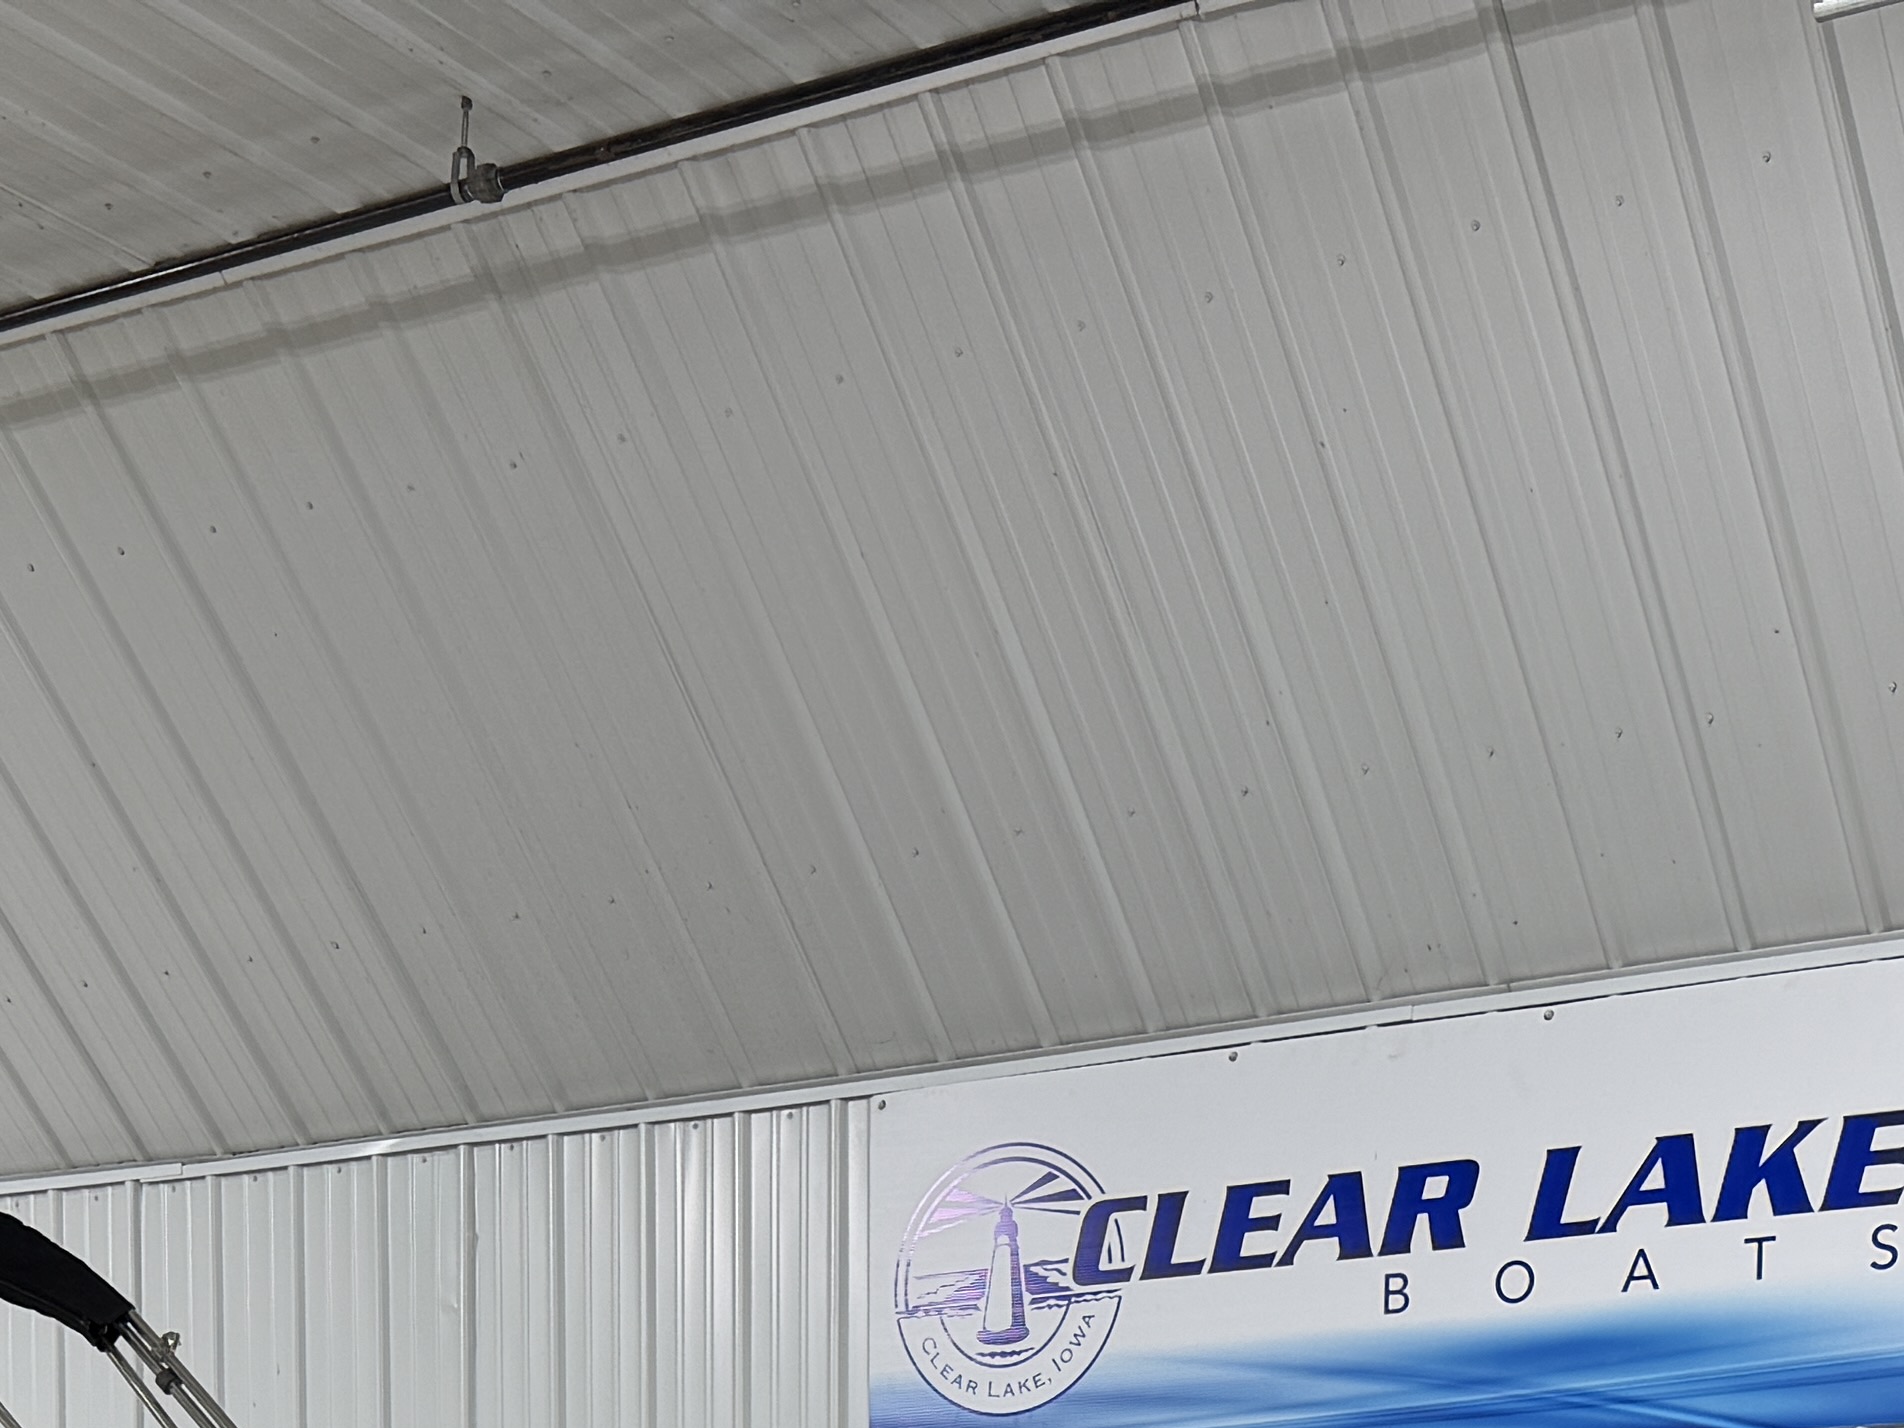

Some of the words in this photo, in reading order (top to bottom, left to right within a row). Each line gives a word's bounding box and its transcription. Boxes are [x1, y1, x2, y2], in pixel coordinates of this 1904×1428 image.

[1072, 1160, 1480, 1286] CLEAR
[1384, 1223, 1899, 1315] BOATS
[921, 1336, 979, 1396] CLEAR
[987, 1372, 1053, 1399] LAKE,
[1051, 1313, 1096, 1373] IOWA
